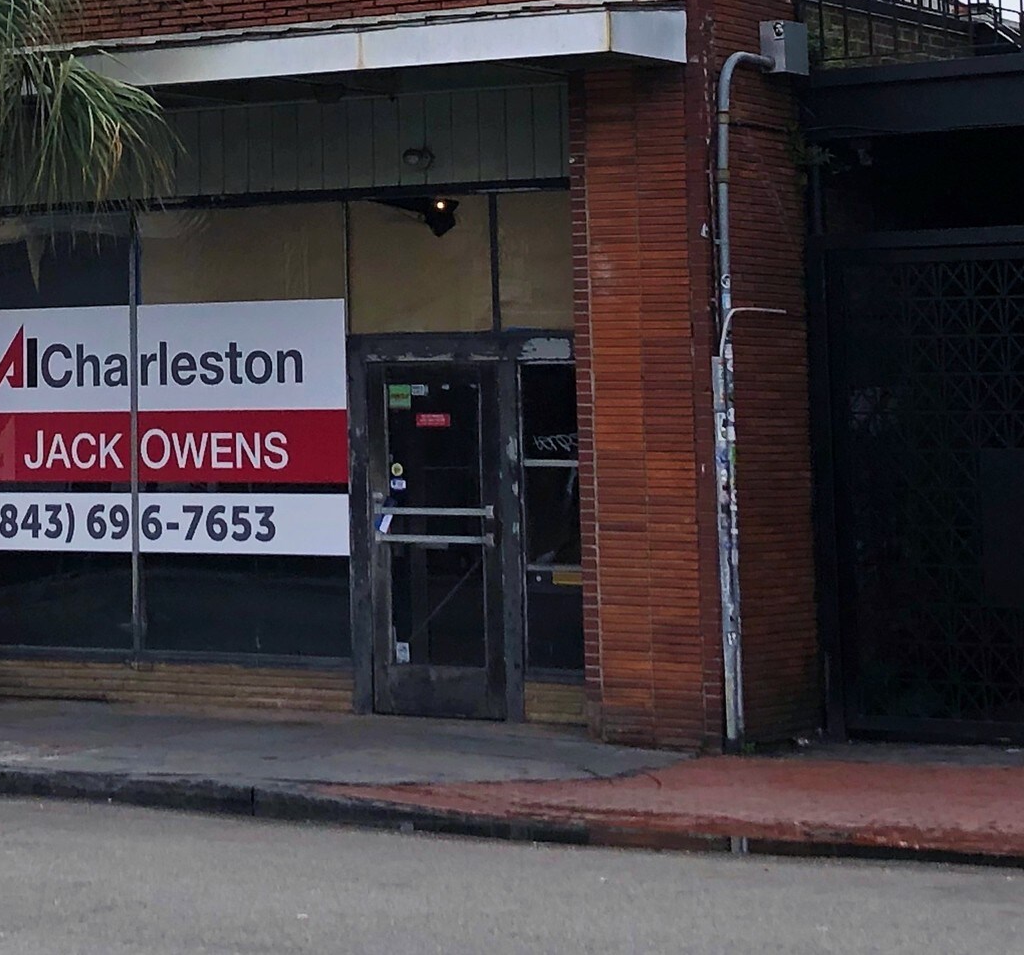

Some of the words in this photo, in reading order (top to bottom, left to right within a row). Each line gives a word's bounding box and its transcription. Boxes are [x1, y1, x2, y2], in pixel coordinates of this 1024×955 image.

[41, 341, 304, 389] Charleston
[24, 429, 125, 470] JACK
[140, 428, 290, 471] OWENS
[86, 503, 277, 543] 696-7653
